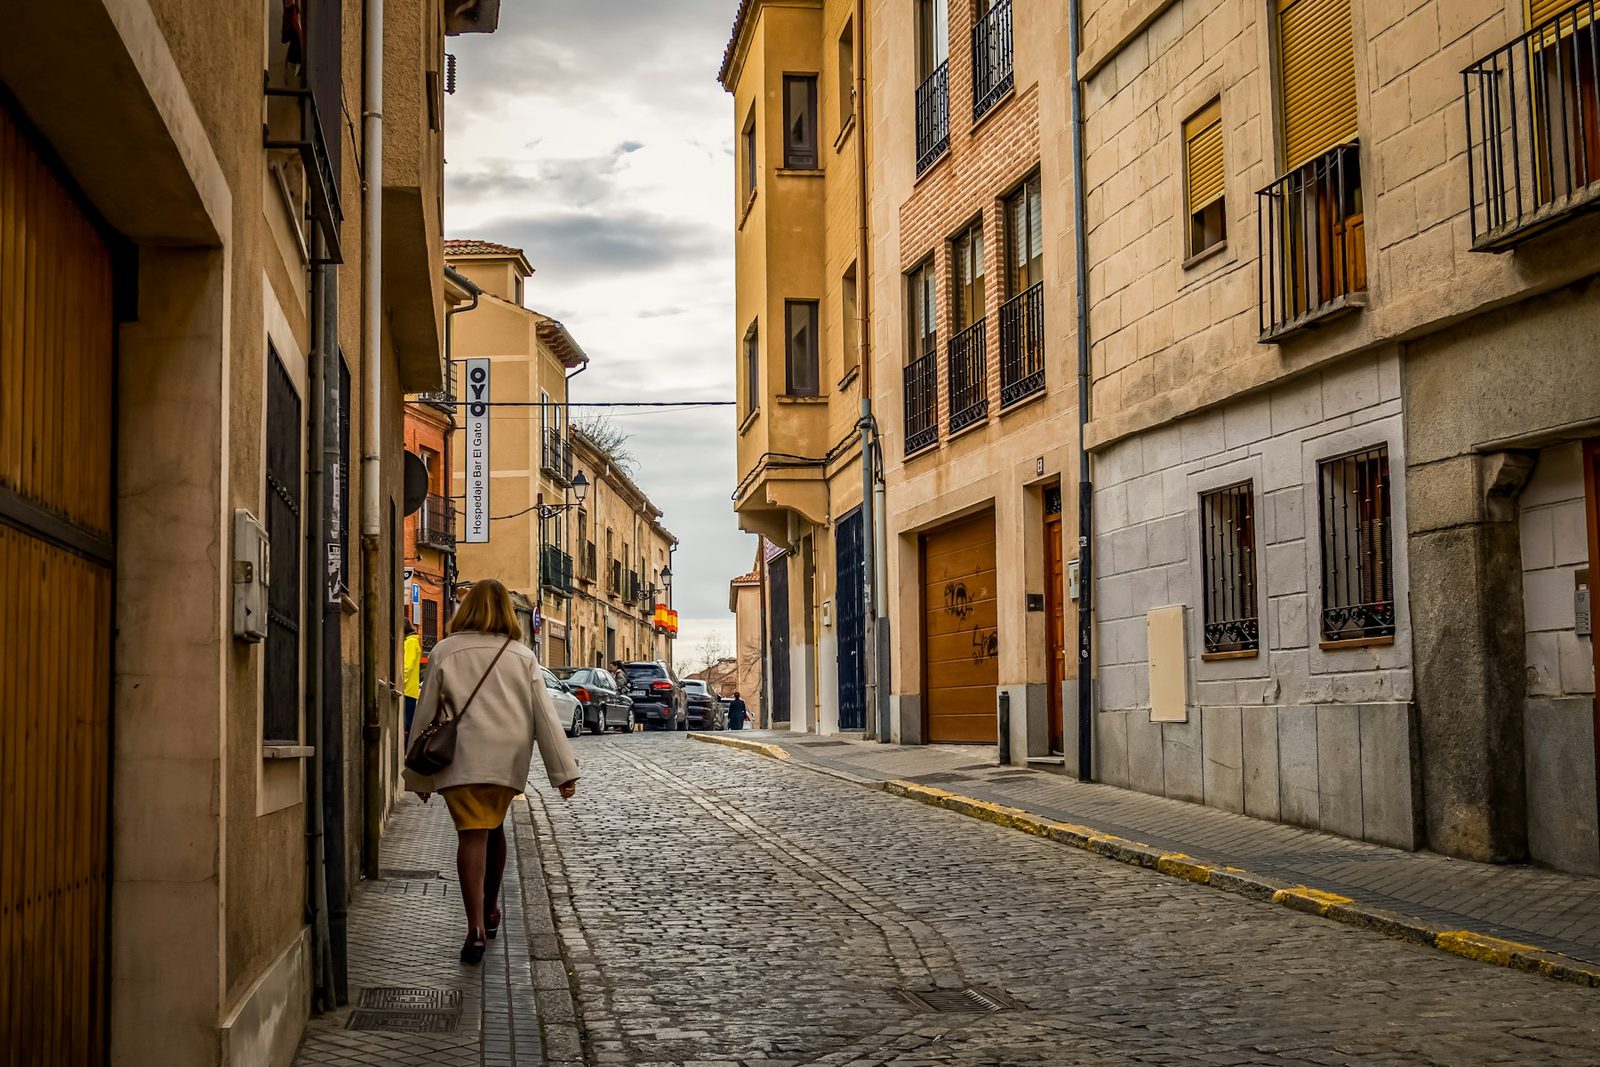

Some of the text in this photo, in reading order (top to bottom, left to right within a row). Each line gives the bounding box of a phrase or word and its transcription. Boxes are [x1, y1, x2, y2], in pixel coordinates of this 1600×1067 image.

[470, 367, 486, 417] OYO
[473, 422, 483, 535] Hospedaje Bar El Gato
